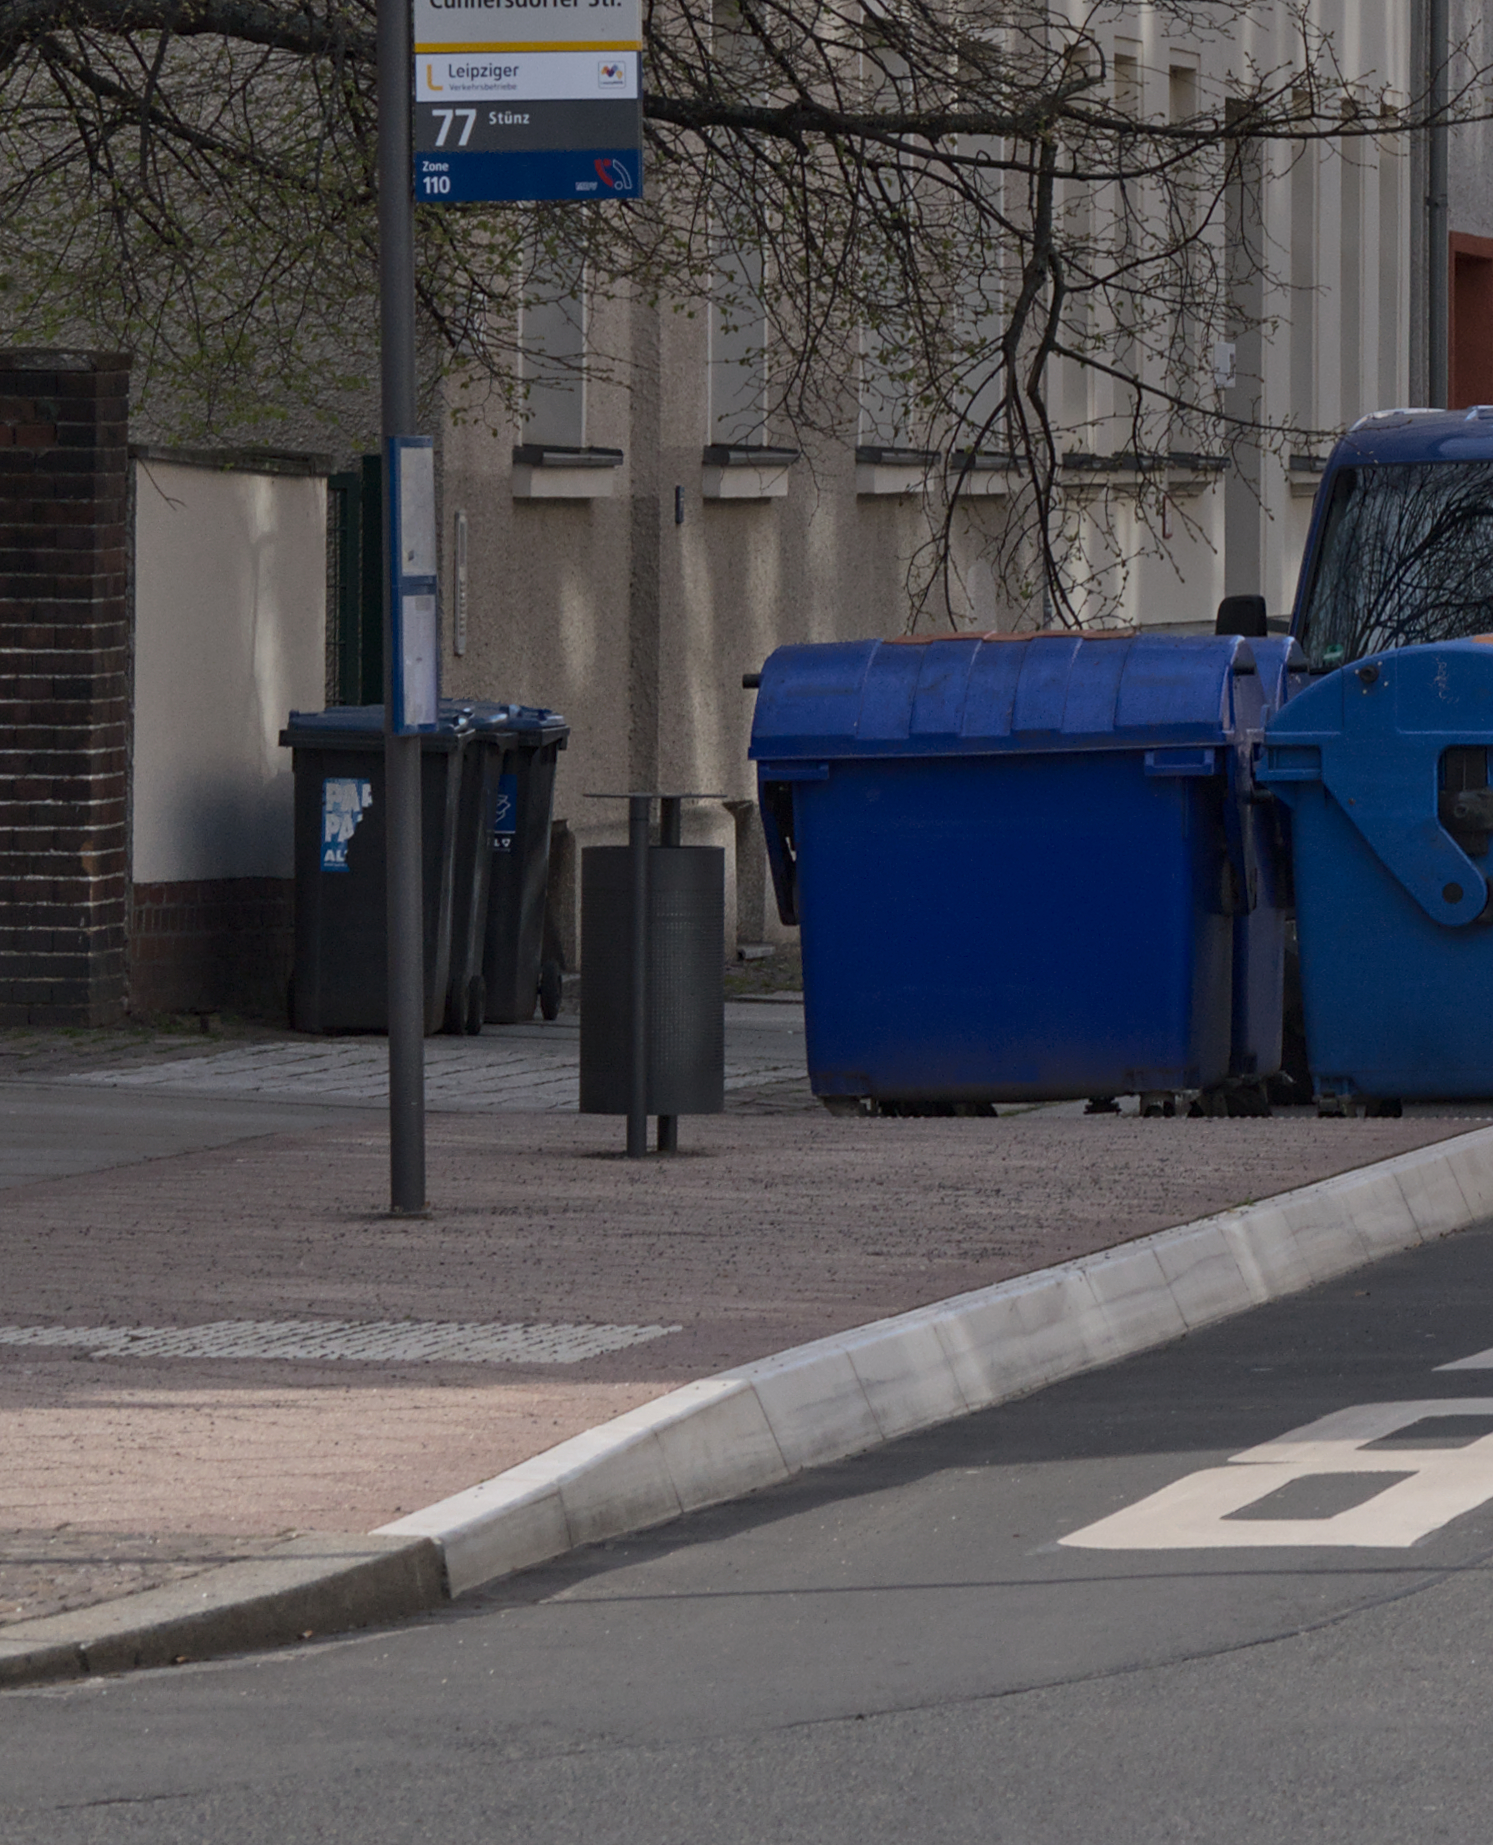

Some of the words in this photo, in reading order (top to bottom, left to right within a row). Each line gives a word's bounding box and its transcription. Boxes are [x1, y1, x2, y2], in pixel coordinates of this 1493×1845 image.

[448, 63, 519, 81] Leipziger
[449, 83, 517, 91] Verkehrsbetriebe
[431, 108, 477, 146] 77
[488, 110, 530, 125] Stünz
[422, 161, 449, 172] Zone
[422, 175, 451, 194] 110
